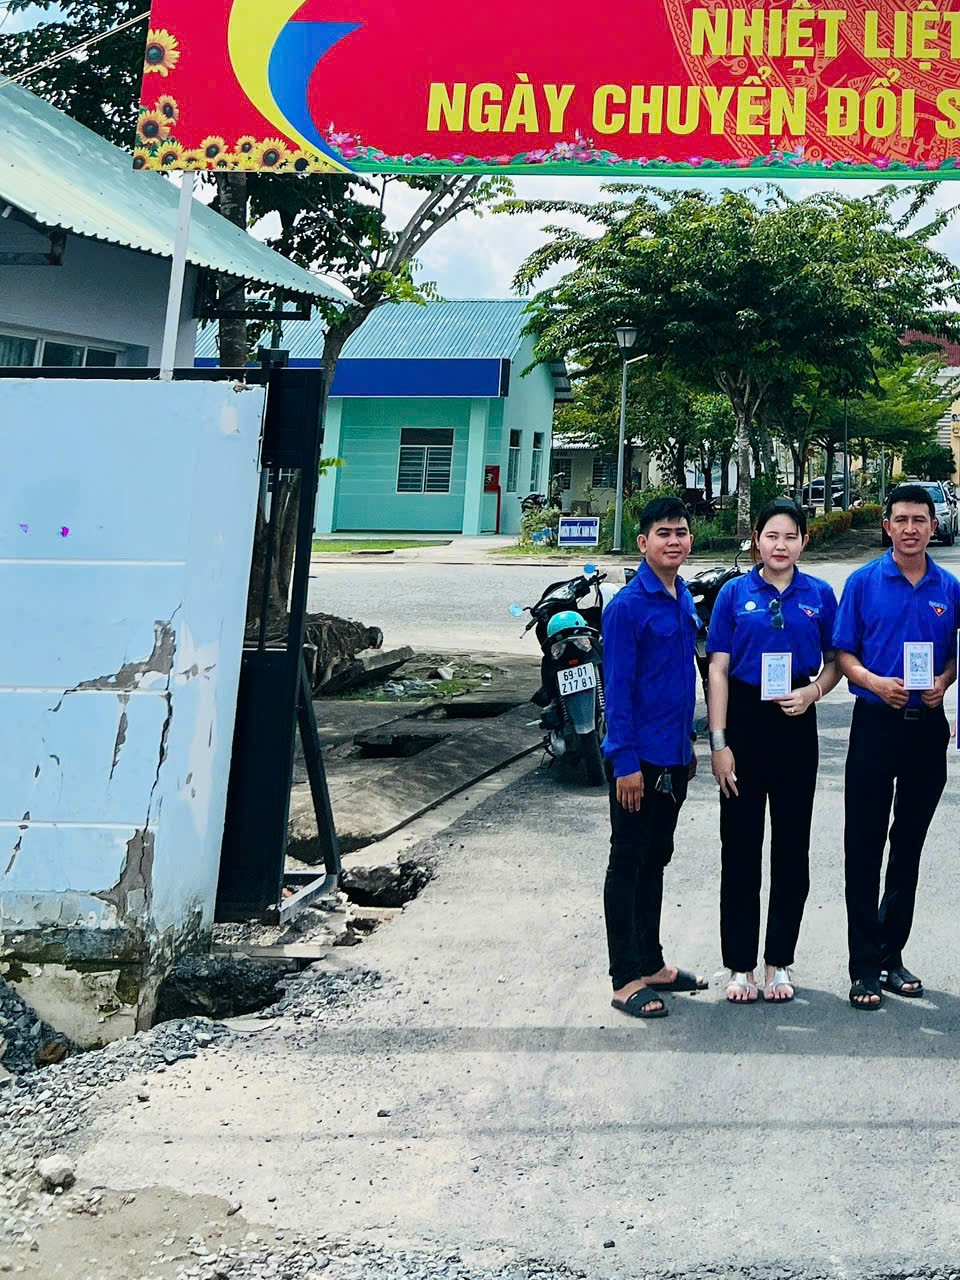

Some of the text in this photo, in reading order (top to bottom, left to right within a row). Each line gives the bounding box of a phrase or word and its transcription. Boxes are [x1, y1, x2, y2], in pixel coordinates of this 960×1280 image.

[691, 0, 848, 68] NHIỆT
[426, 72, 575, 134] NGÀY
[592, 66, 807, 137] CHUYỂN
[825, 68, 915, 139] ĐỔI
